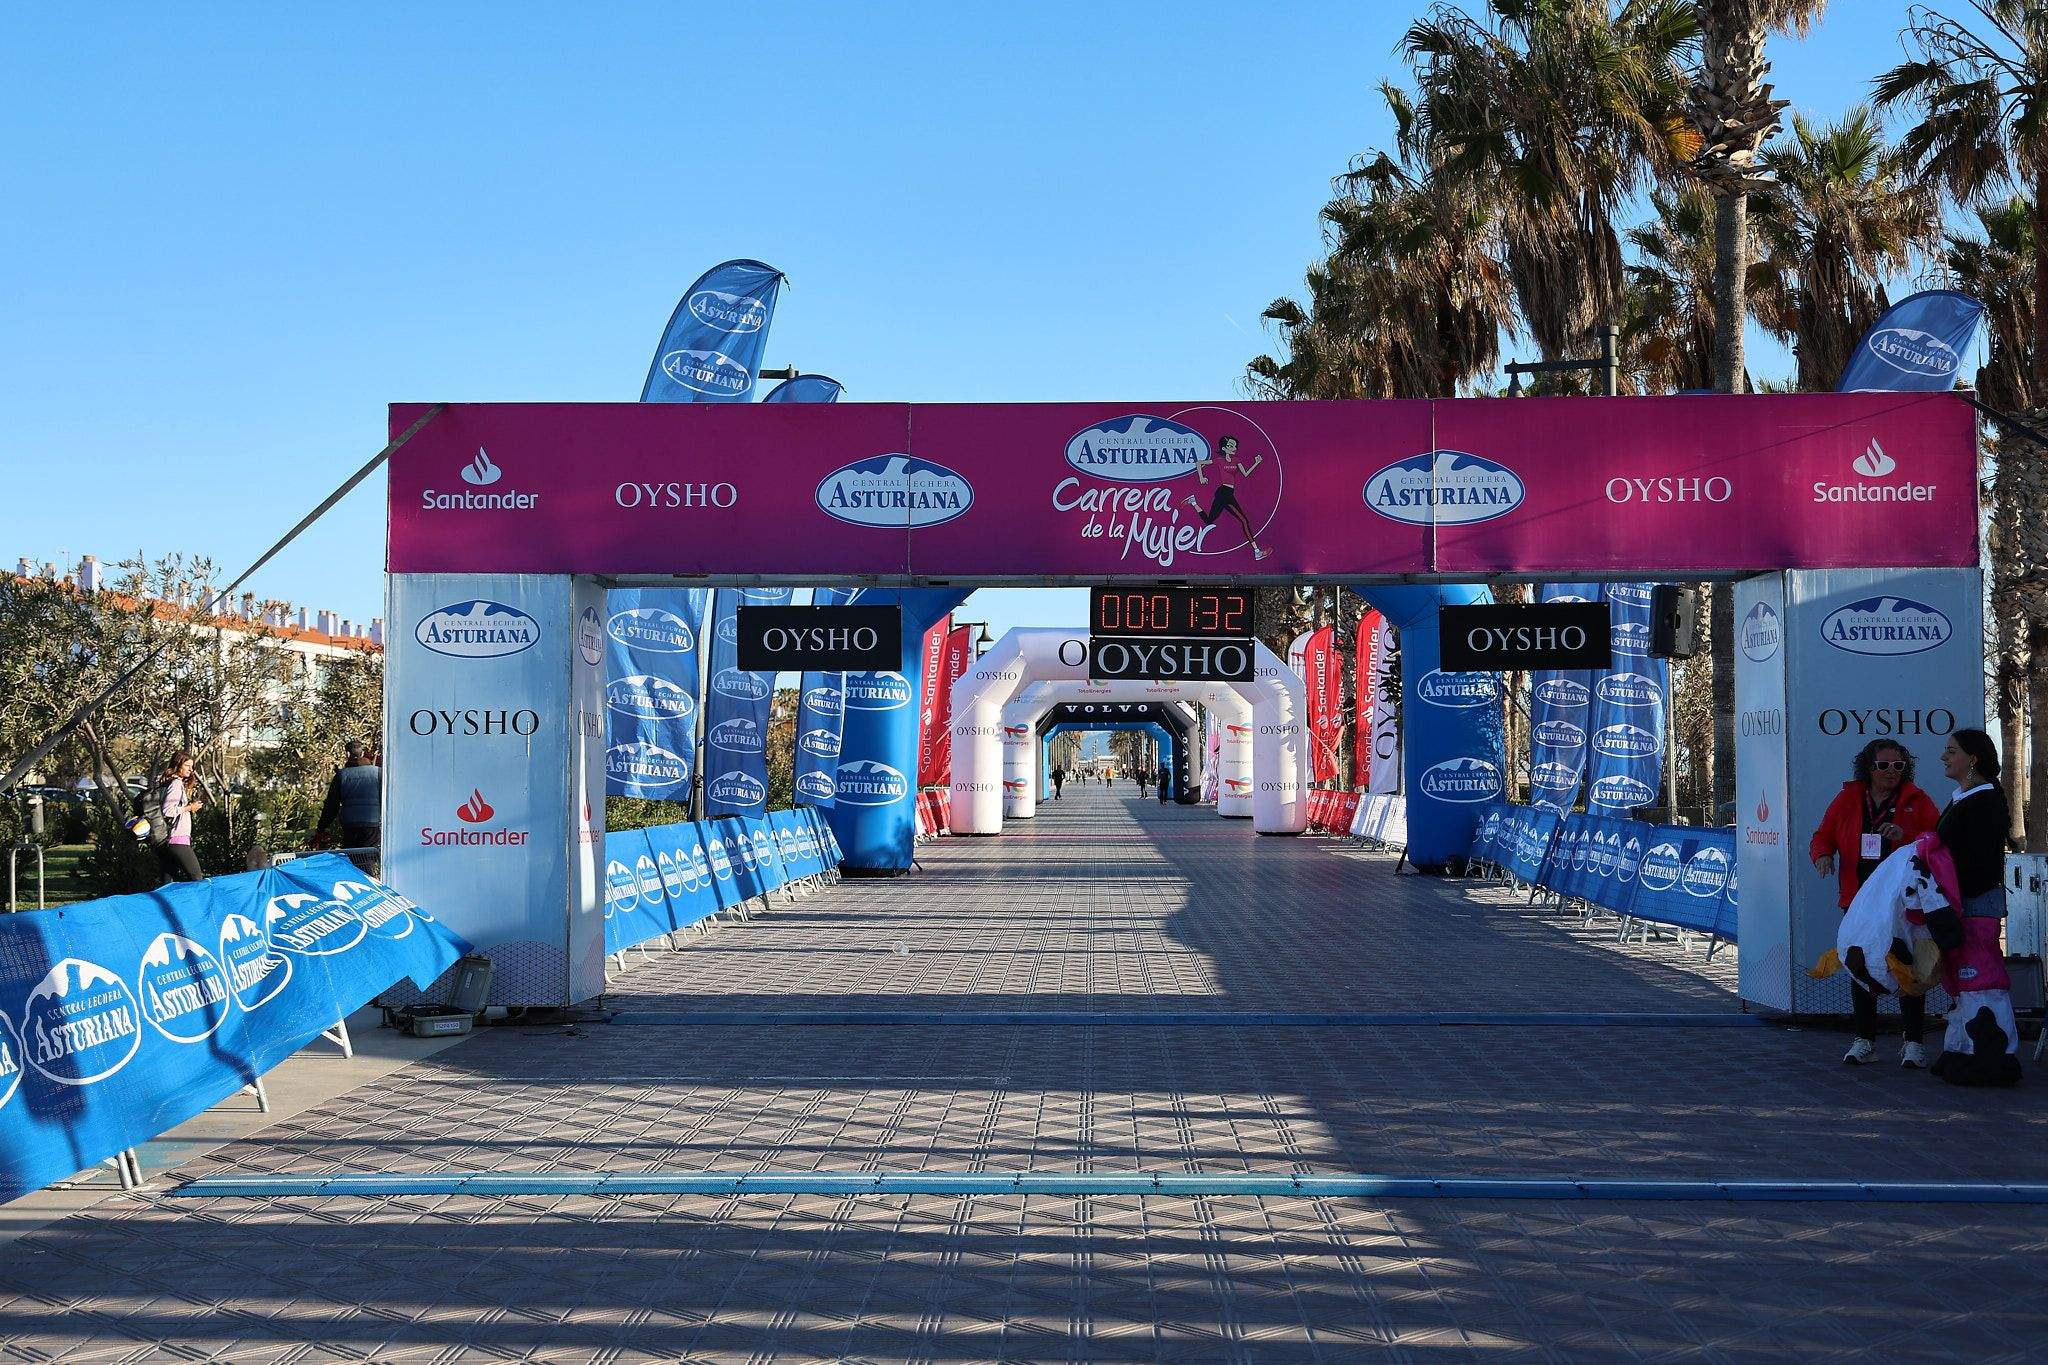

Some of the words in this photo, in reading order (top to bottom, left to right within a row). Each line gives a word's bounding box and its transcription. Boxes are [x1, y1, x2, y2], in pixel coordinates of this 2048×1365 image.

[1874, 335, 1951, 372] ASTURIANA
[668, 356, 744, 391] ASTURIANA
[1076, 439, 1199, 465] ASTURIANA
[1098, 437, 1143, 445] CENTRAL
[1148, 437, 1196, 445] LECHERA
[852, 479, 903, 488] CENTRAL
[907, 479, 957, 488] LECHERA
[1377, 477, 1513, 506] ASTURIANA
[1400, 475, 1449, 485] CENTRAL
[1454, 475, 1508, 485] LECHERA
[1606, 476, 1733, 504] OYSHO
[1813, 480, 1937, 503] Santander
[422, 489, 539, 509] Santander
[614, 482, 738, 508] OYSHO
[828, 481, 962, 509] ASTURIANA
[1052, 476, 1172, 513] Carrera
[1081, 514, 1104, 538] de
[1108, 513, 1125, 538] la
[1121, 509, 1216, 567] Mujer
[425, 622, 531, 644] ASTURIANA
[613, 619, 688, 649] ASTURIANA
[762, 627, 878, 651] OYSHO
[1467, 625, 1586, 651] OYSHO
[1744, 626, 1778, 649] ASTURIANA
[1832, 618, 1943, 641] ASTURIANA
[924, 630, 942, 706] Santander
[1097, 643, 1247, 676] OYSHO
[1365, 628, 1379, 703] Santander
[976, 671, 1018, 681] OYSHO
[1315, 649, 1327, 713] Santander
[608, 687, 686, 712] ASTURIANA
[845, 687, 907, 701] STURIANA
[1423, 680, 1497, 697] ASTURIANA
[1540, 686, 1588, 702] ASTURIANA
[1600, 682, 1659, 701] ASTURIANA
[1065, 704, 1148, 713] VOLVO
[410, 709, 540, 736] OYSHO
[956, 727, 995, 736] OYSHO
[1260, 725, 1299, 735] OYSHO
[1741, 708, 1782, 738] OYSHO
[1819, 708, 1956, 736] OYSHO
[1537, 729, 1582, 744] ASTURIANA
[1597, 735, 1654, 752] ASTURIANA
[921, 728, 932, 774] Sports
[606, 754, 680, 778] ASTURIANA
[713, 784, 761, 801] ASTURIANA
[955, 782, 994, 792] OYSHO
[1261, 782, 1300, 792] OYSHO
[1426, 775, 1499, 792] ASTURIANA
[1593, 786, 1648, 802] ASTURIANA
[421, 827, 529, 846] Santander
[1745, 827, 1780, 846] Santander
[1684, 864, 1723, 887] ASTURIANA
[157, 969, 186, 986] CENTRAL
[187, 960, 214, 977] LECHERA
[48, 1001, 86, 1020] CENTRAL
[88, 989, 123, 1009] LECHERA
[148, 974, 227, 1024] ASTURIANA
[36, 1005, 136, 1064] ASTURIANA
